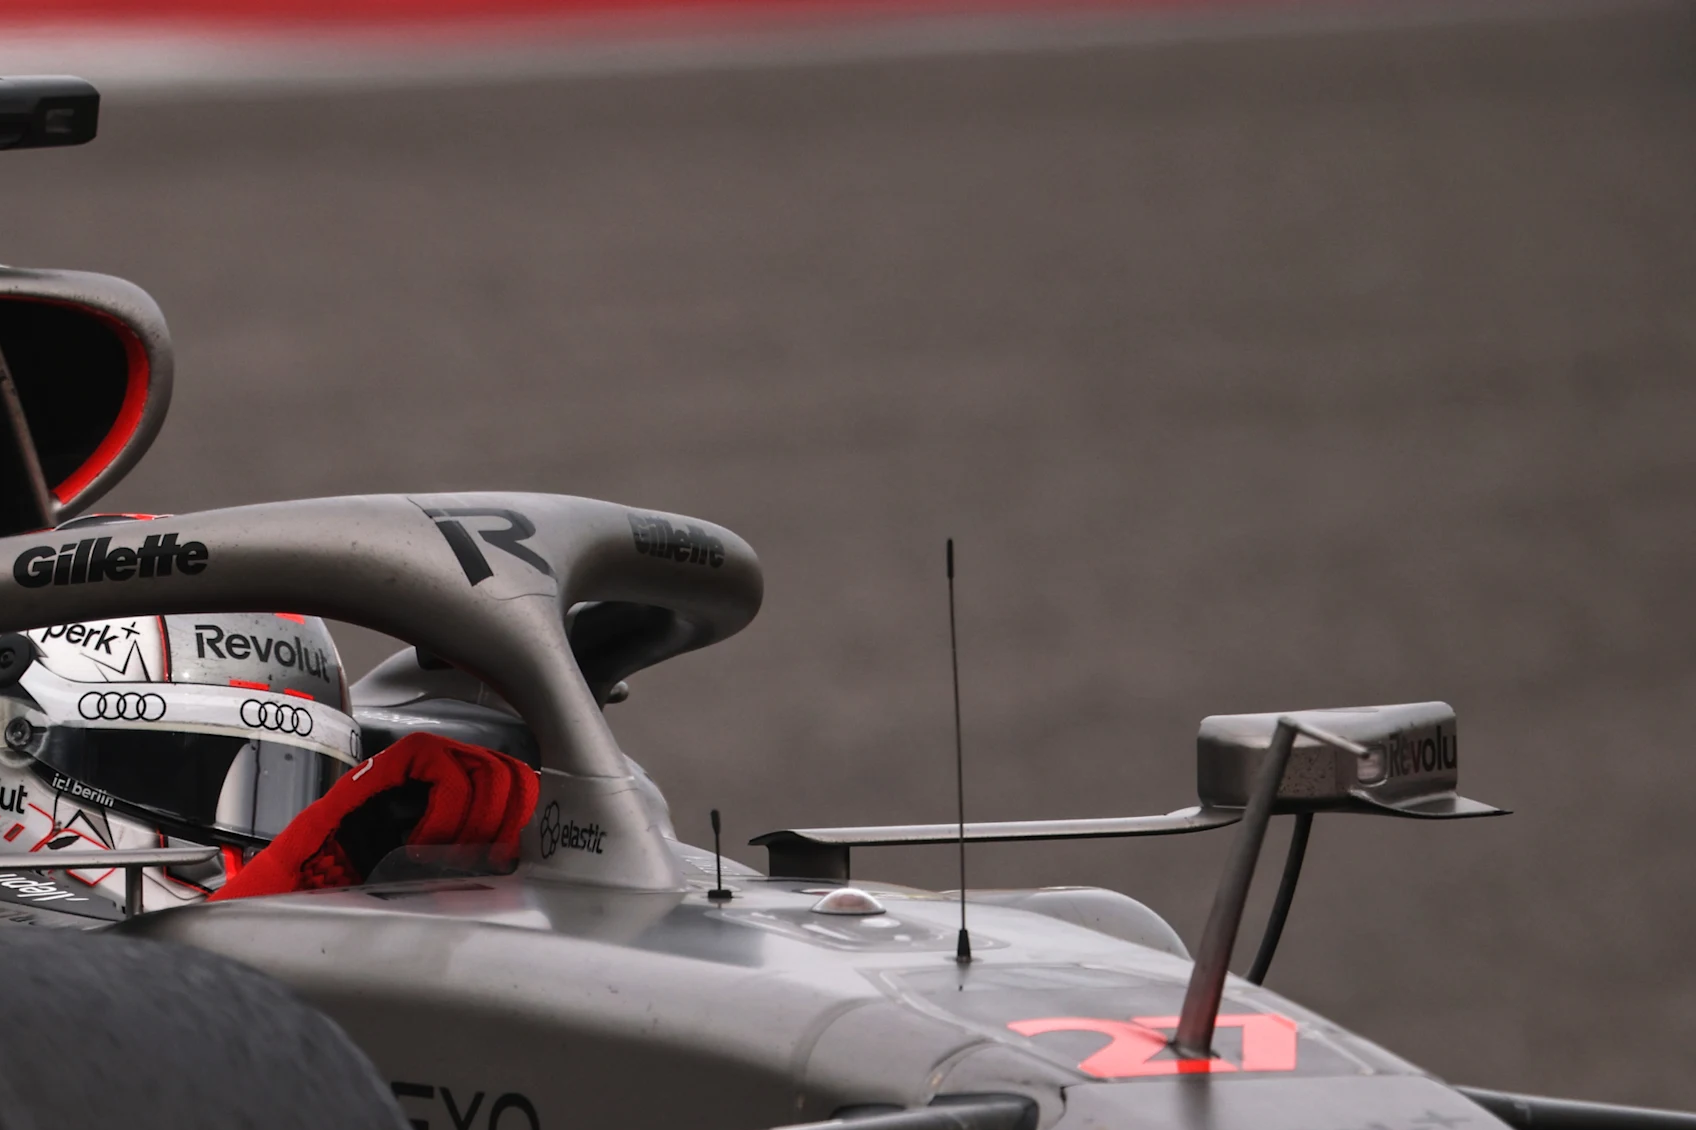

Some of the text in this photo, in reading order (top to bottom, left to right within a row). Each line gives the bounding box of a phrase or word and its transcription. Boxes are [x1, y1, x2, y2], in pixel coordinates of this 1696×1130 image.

[13, 532, 209, 588] Gillette
[627, 512, 725, 569] Gillette
[194, 624, 331, 683] Revolut
[71, 780, 115, 808] berlin
[561, 819, 608, 855] elastic
